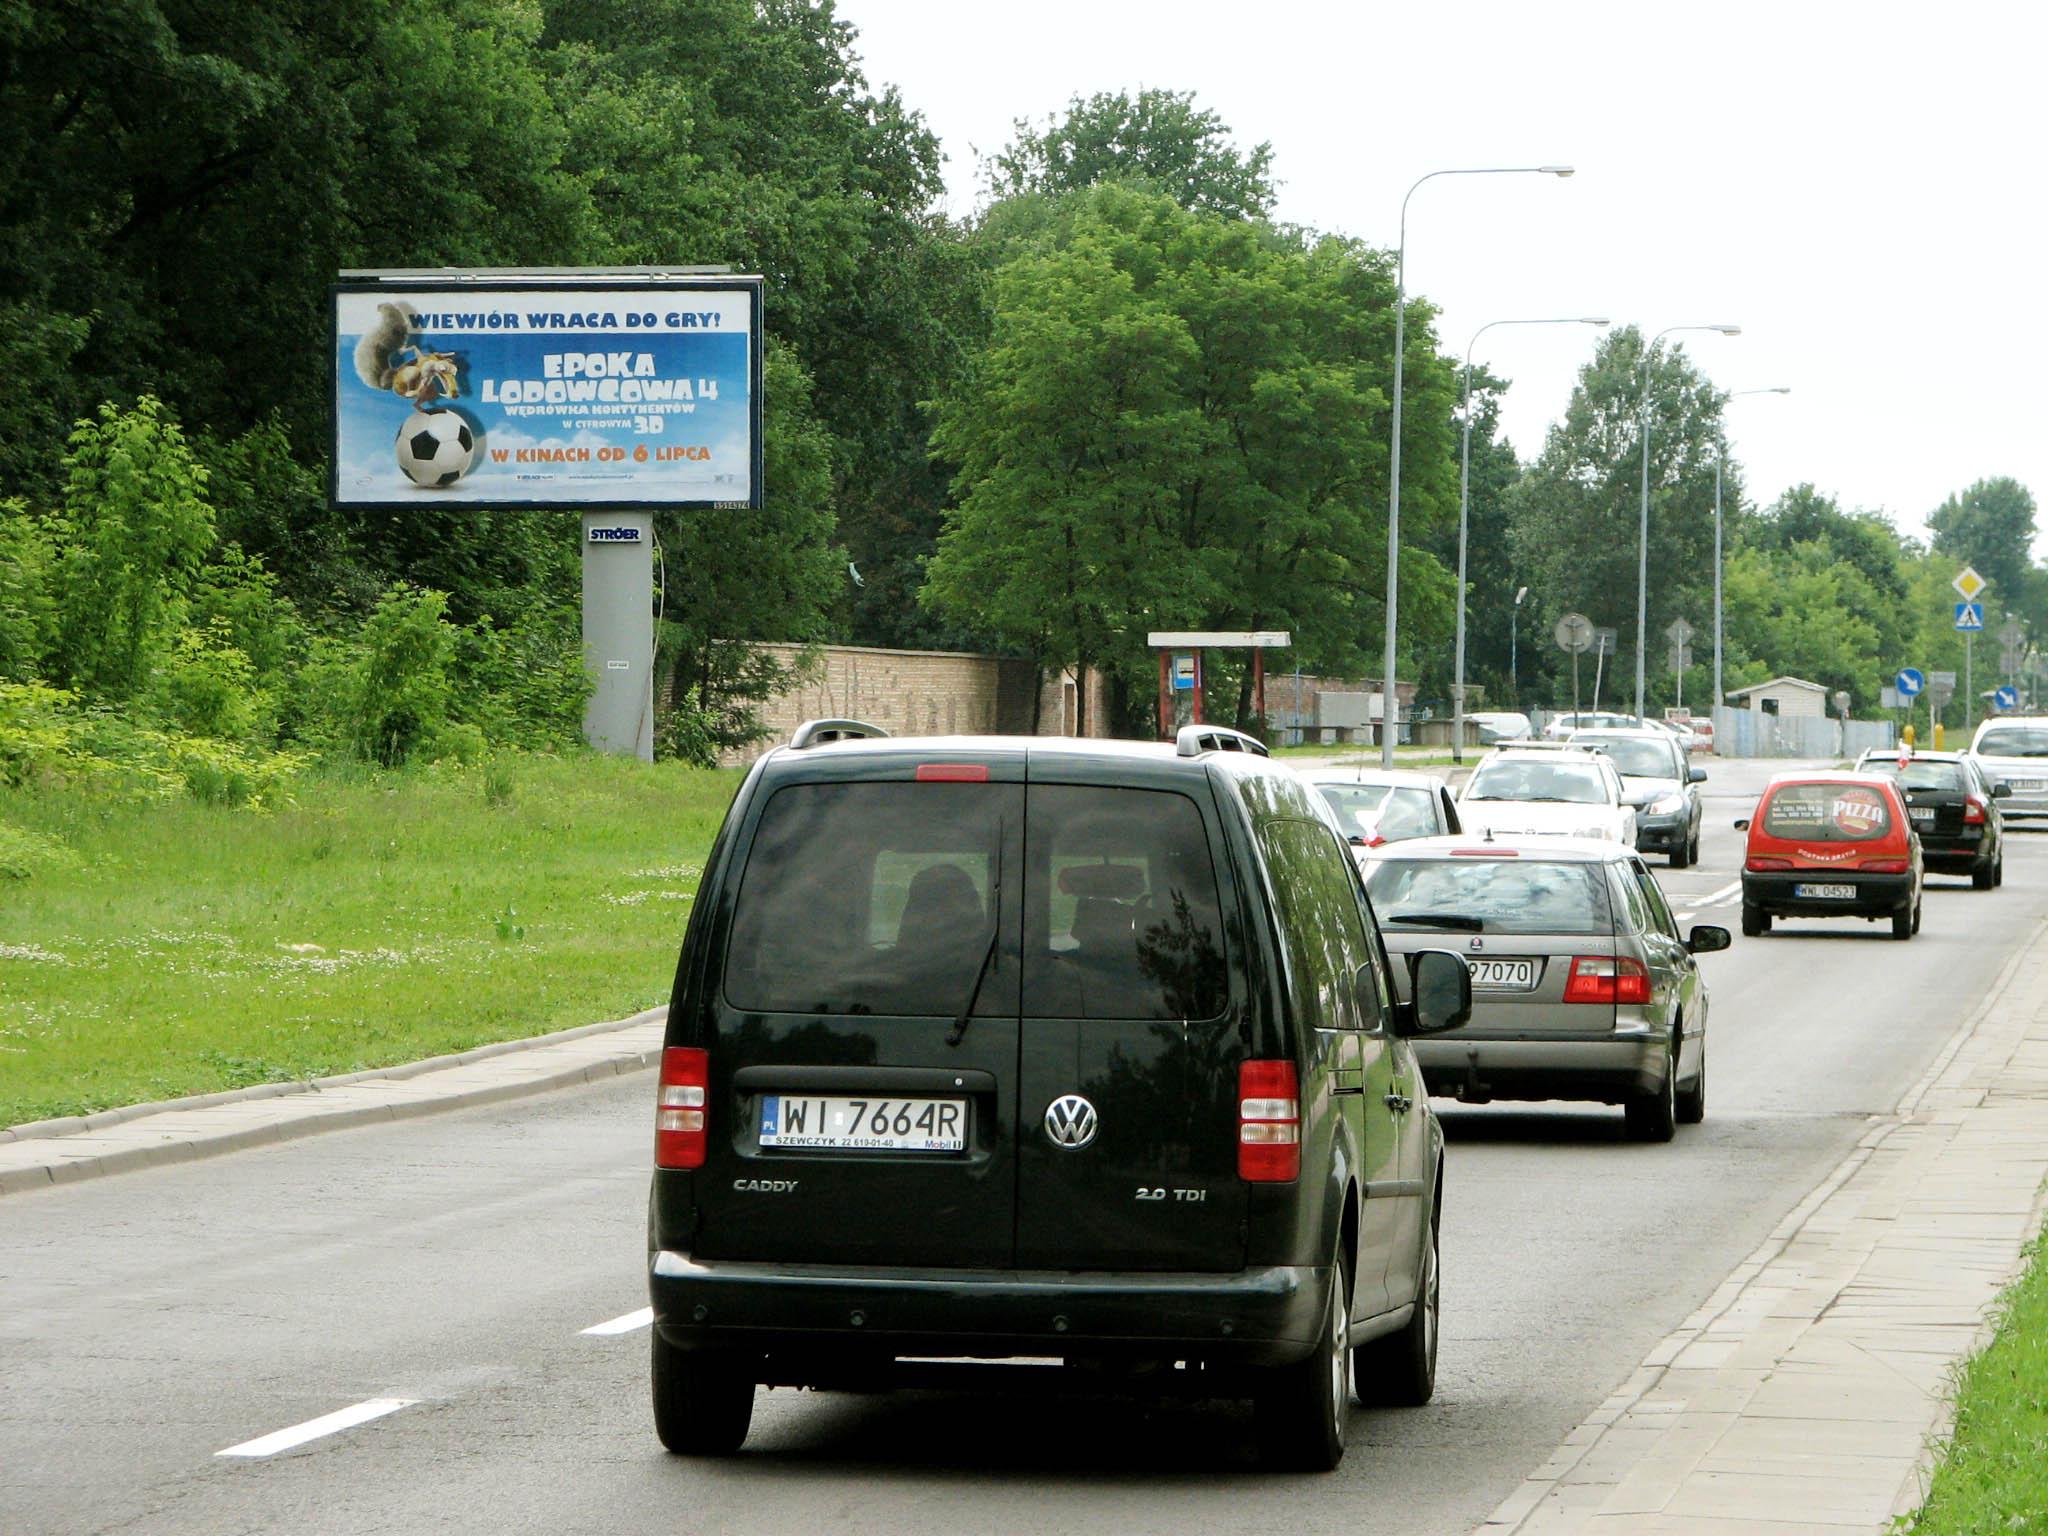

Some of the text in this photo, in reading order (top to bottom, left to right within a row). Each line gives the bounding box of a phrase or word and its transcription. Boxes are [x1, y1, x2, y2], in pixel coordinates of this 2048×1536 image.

[408, 310, 721, 329] WIEWIÓR WRACA DO GRY!
[543, 352, 656, 378] EPOKA
[481, 379, 718, 404] LODOWCOWA 4
[504, 403, 696, 418] WĘDRÓWKA KONTYNENTÓW
[562, 415, 664, 434] W CYFROWYM 3D
[491, 444, 711, 463] W KINACH OD 6 LIPCA
[591, 527, 639, 540] STRÖER
[1832, 799, 1883, 823] PIZZA
[848, 1101, 959, 1138] 7664R
[775, 1137, 836, 1146] SZEWCZYK
[925, 1139, 951, 1149] Mobil
[733, 1179, 799, 1193] CADDY
[1173, 1189, 1207, 1202] TDI
